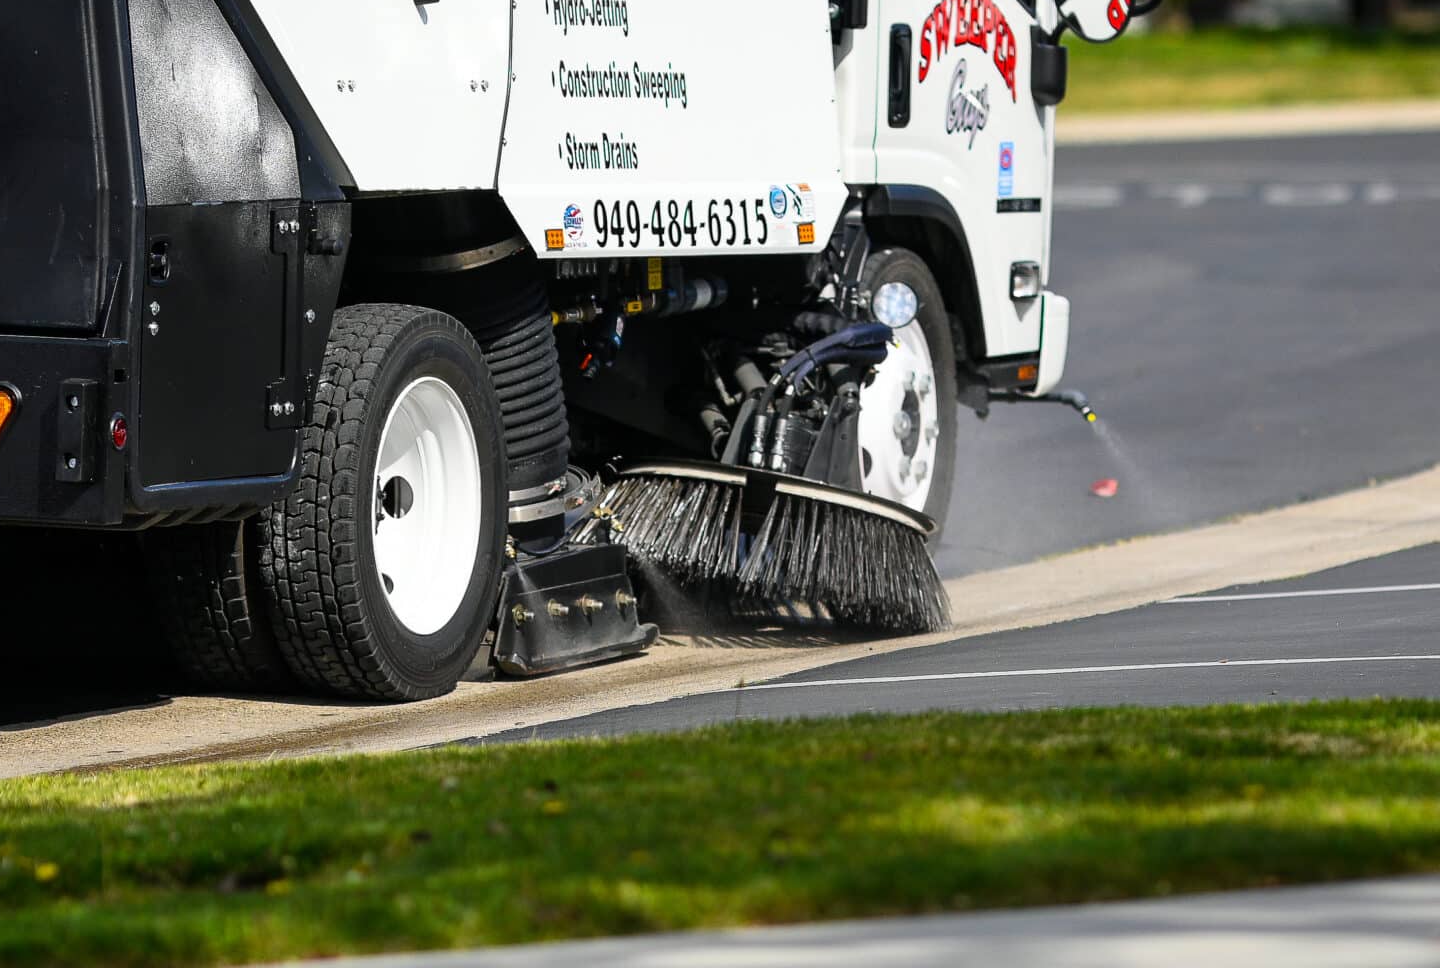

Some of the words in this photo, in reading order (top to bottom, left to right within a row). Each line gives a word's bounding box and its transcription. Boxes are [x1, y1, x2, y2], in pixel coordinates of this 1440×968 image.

[559, 59, 632, 98] Construction
[633, 61, 688, 109] Sweeping
[565, 131, 601, 170] Storm
[601, 132, 639, 170] Drains
[593, 198, 768, 248] 949-484-6315
